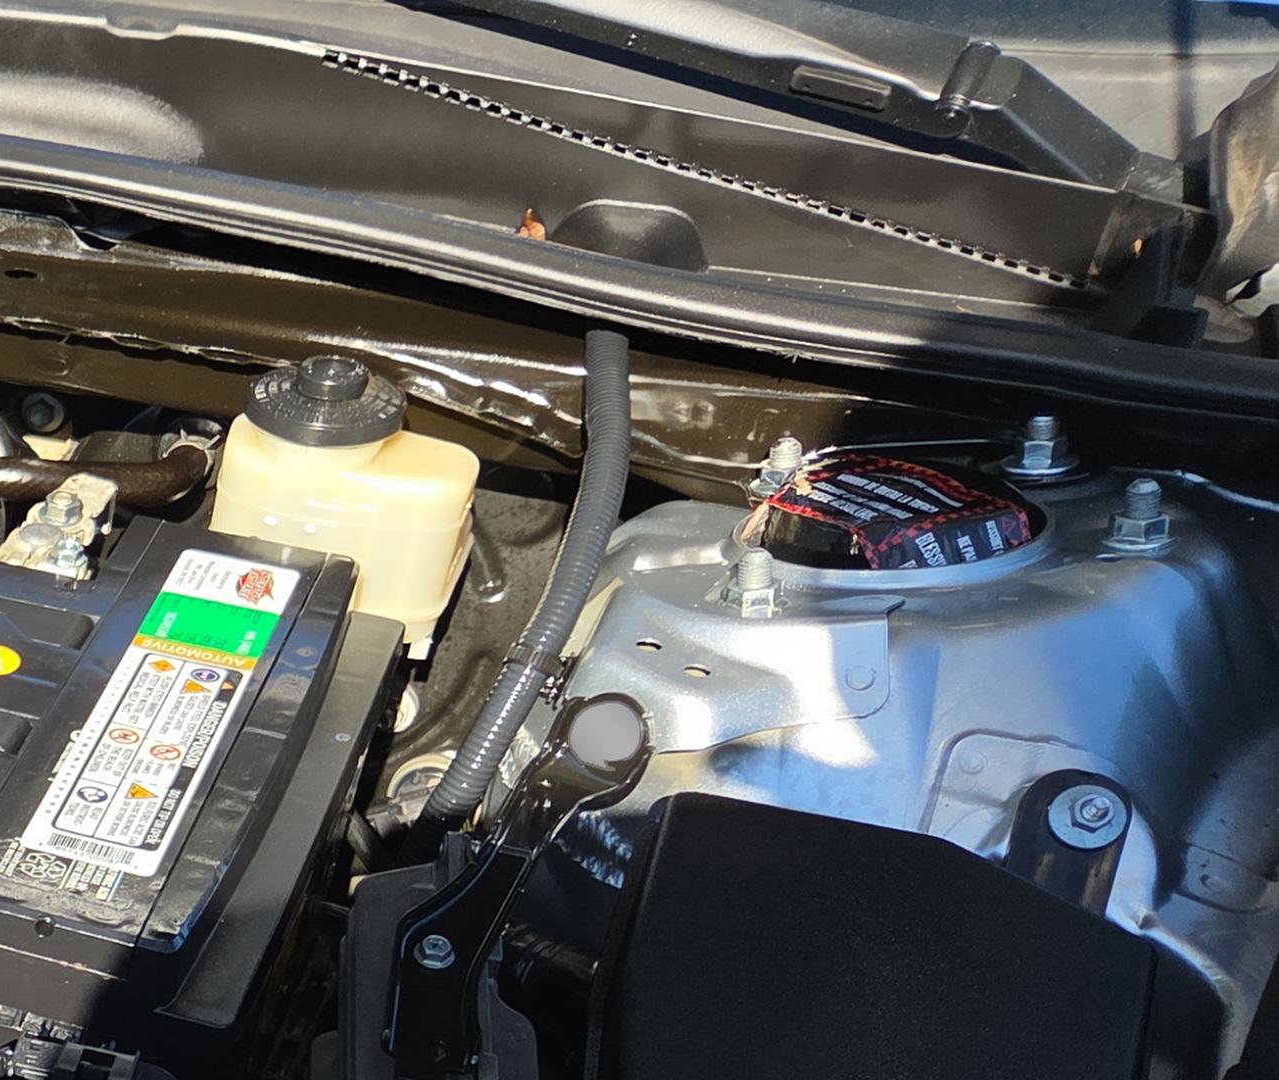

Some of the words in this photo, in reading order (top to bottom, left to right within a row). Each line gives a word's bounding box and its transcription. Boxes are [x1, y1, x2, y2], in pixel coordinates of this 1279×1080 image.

[138, 636, 246, 668] AUTOMOTIVE
[180, 699, 228, 770] DANGER/POISON
[160, 797, 178, 811] NOT
